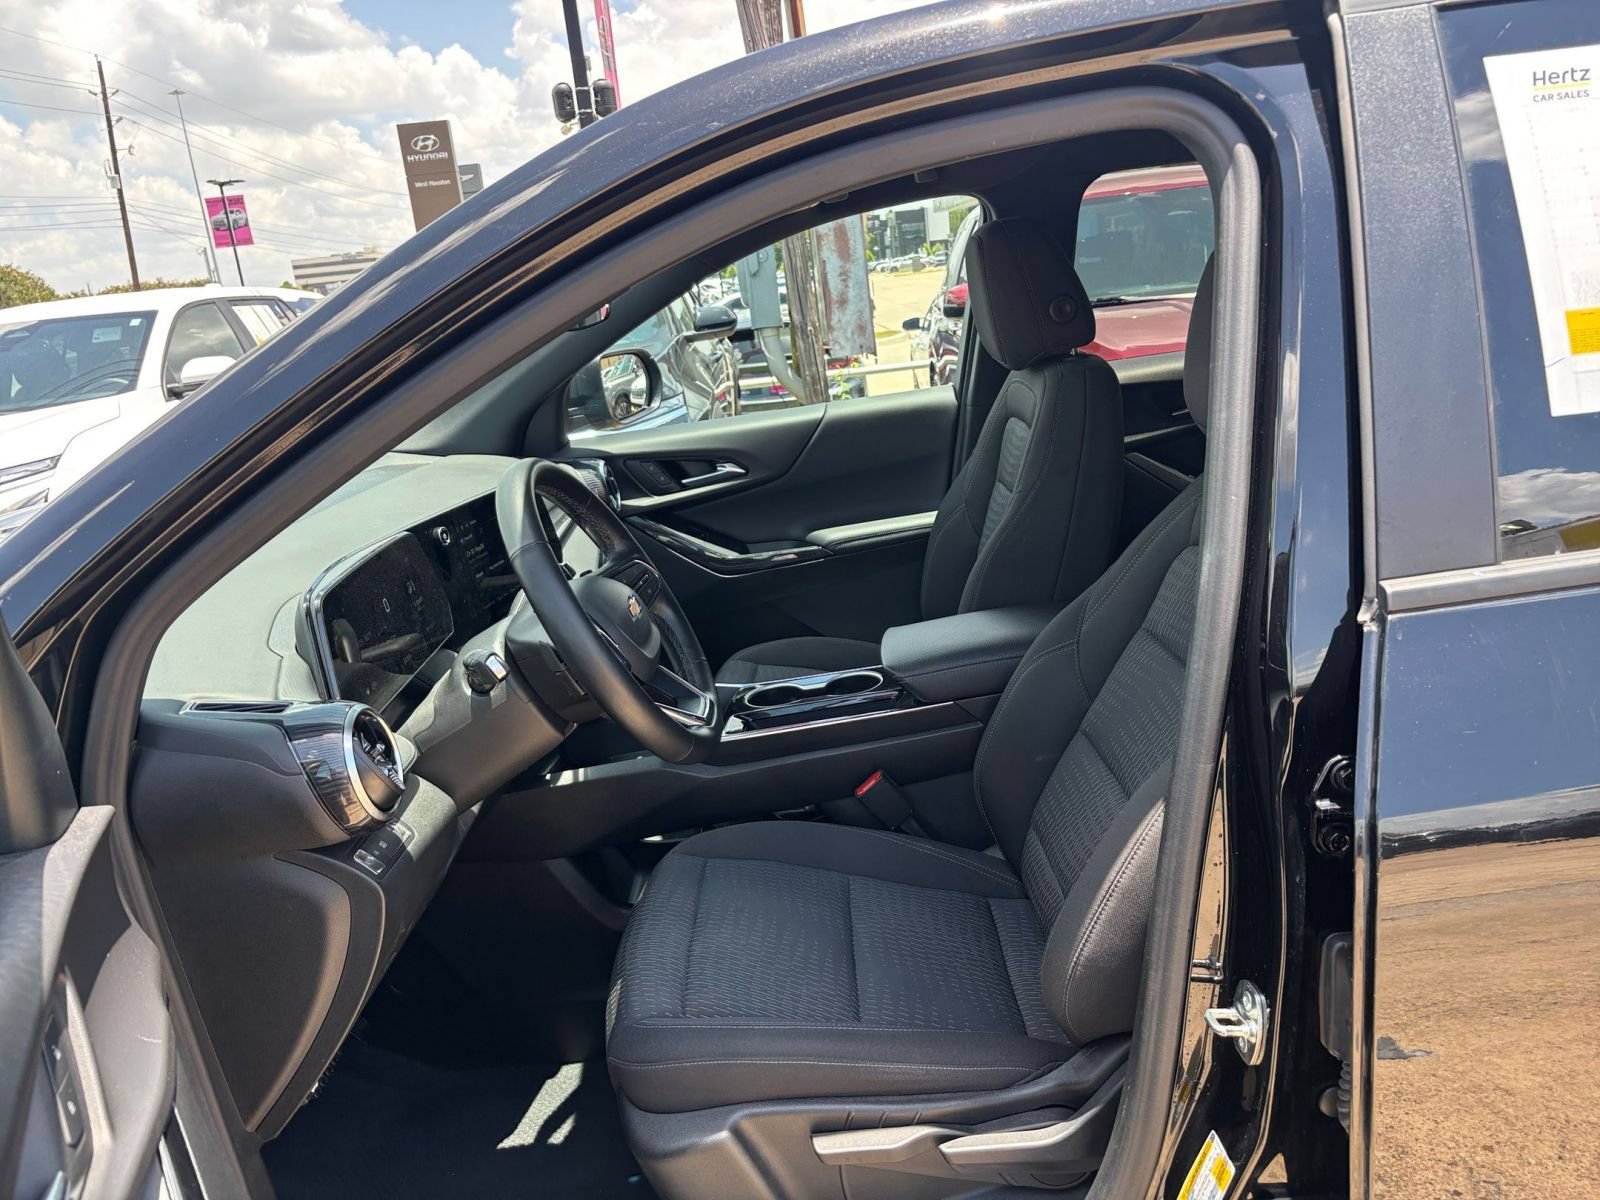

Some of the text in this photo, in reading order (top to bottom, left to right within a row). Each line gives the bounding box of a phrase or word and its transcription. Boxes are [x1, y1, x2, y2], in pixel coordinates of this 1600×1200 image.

[1533, 67, 1591, 86] Hertz
[1533, 90, 1590, 102] CAR SALES
[407, 152, 448, 162] HYUNDAI
